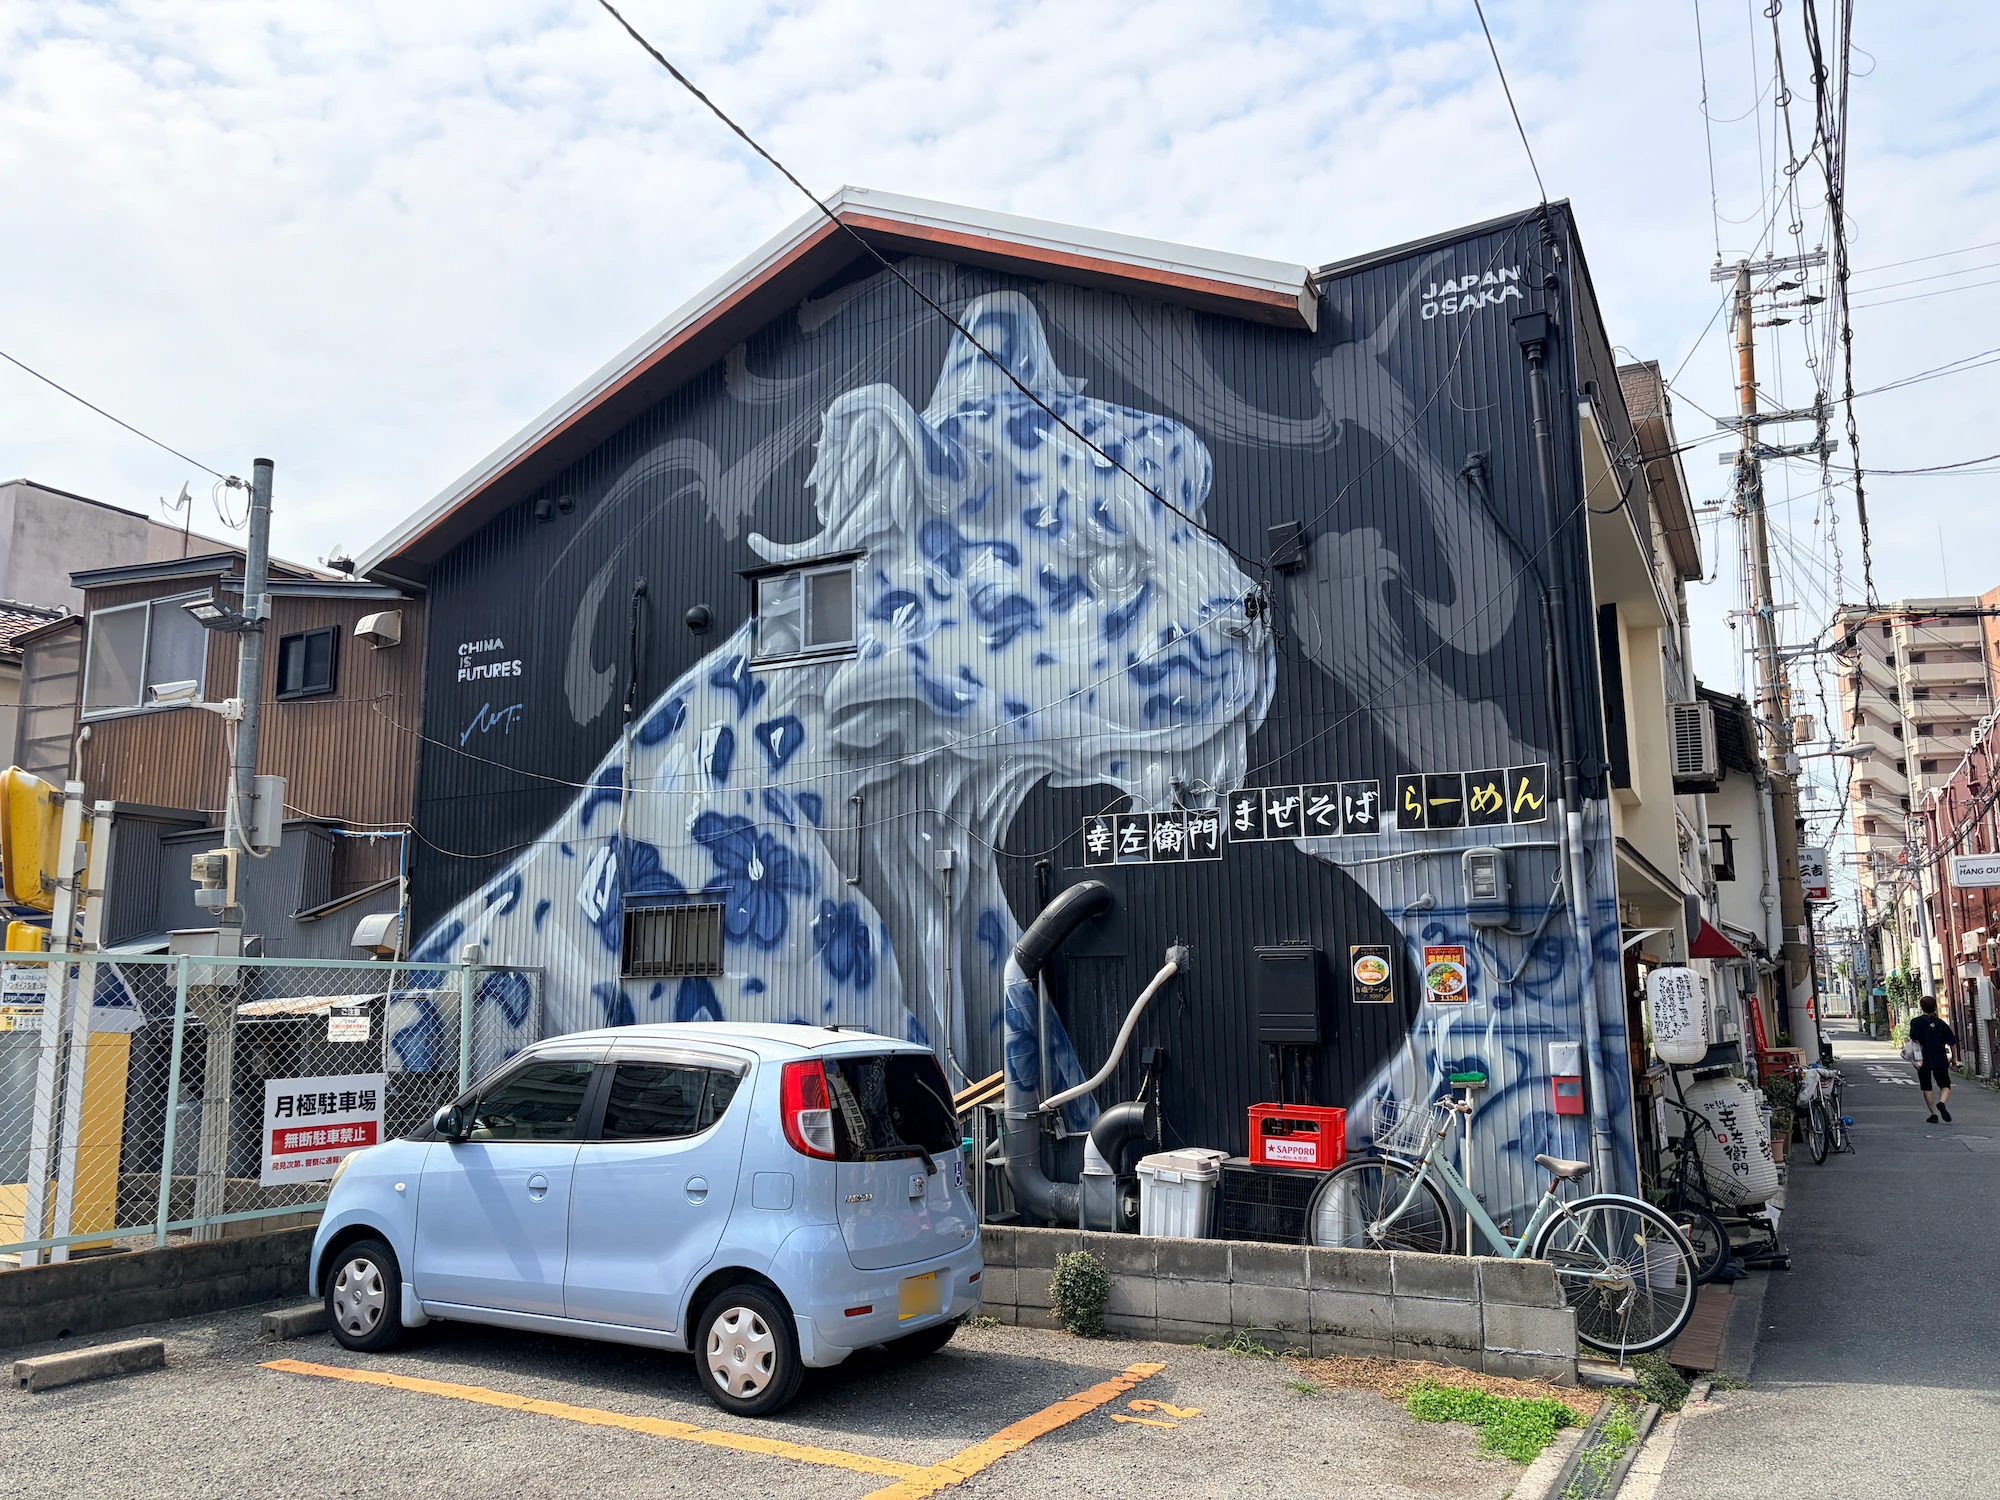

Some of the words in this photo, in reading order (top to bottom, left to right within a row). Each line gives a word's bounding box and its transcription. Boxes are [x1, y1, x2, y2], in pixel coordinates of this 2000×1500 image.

[1422, 265, 1520, 299] JAPAN
[1422, 285, 1523, 320] OSAKA
[458, 638, 504, 655] CHINA
[460, 656, 472, 668] IS
[458, 660, 522, 682] FUTURES
[1234, 789, 1379, 831] まぜそば
[1404, 777, 1544, 821] らーめん
[1087, 815, 1218, 856] 幸左衛門
[274, 1090, 376, 1118] 月極駐車場
[284, 1127, 367, 1149] 無断駐車禁止
[1276, 1145, 1315, 1156] SAPPORO
[1718, 1109, 1749, 1176] 幸左衛門
